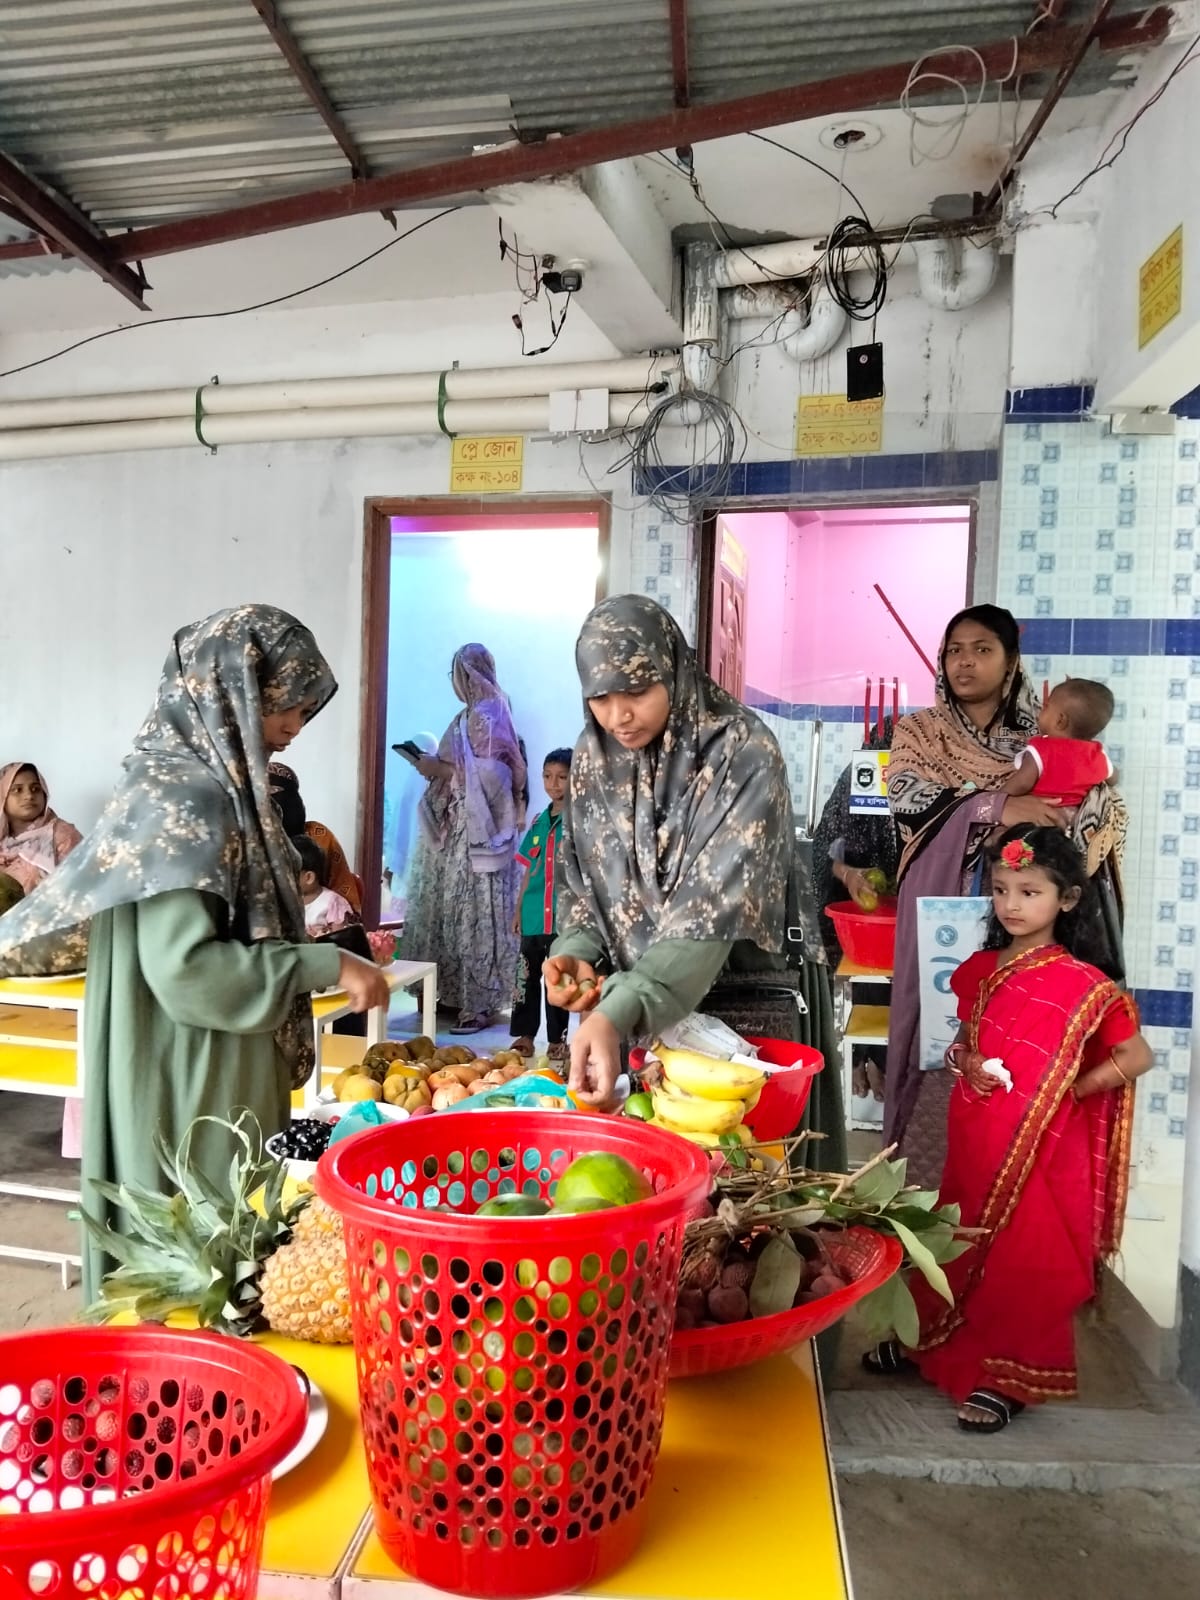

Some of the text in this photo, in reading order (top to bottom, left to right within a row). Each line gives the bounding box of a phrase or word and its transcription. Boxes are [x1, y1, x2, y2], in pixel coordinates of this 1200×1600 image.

[462, 441, 517, 460] প্লে জোন
[456, 470, 518, 484] কক্ষ নং-১০৪
